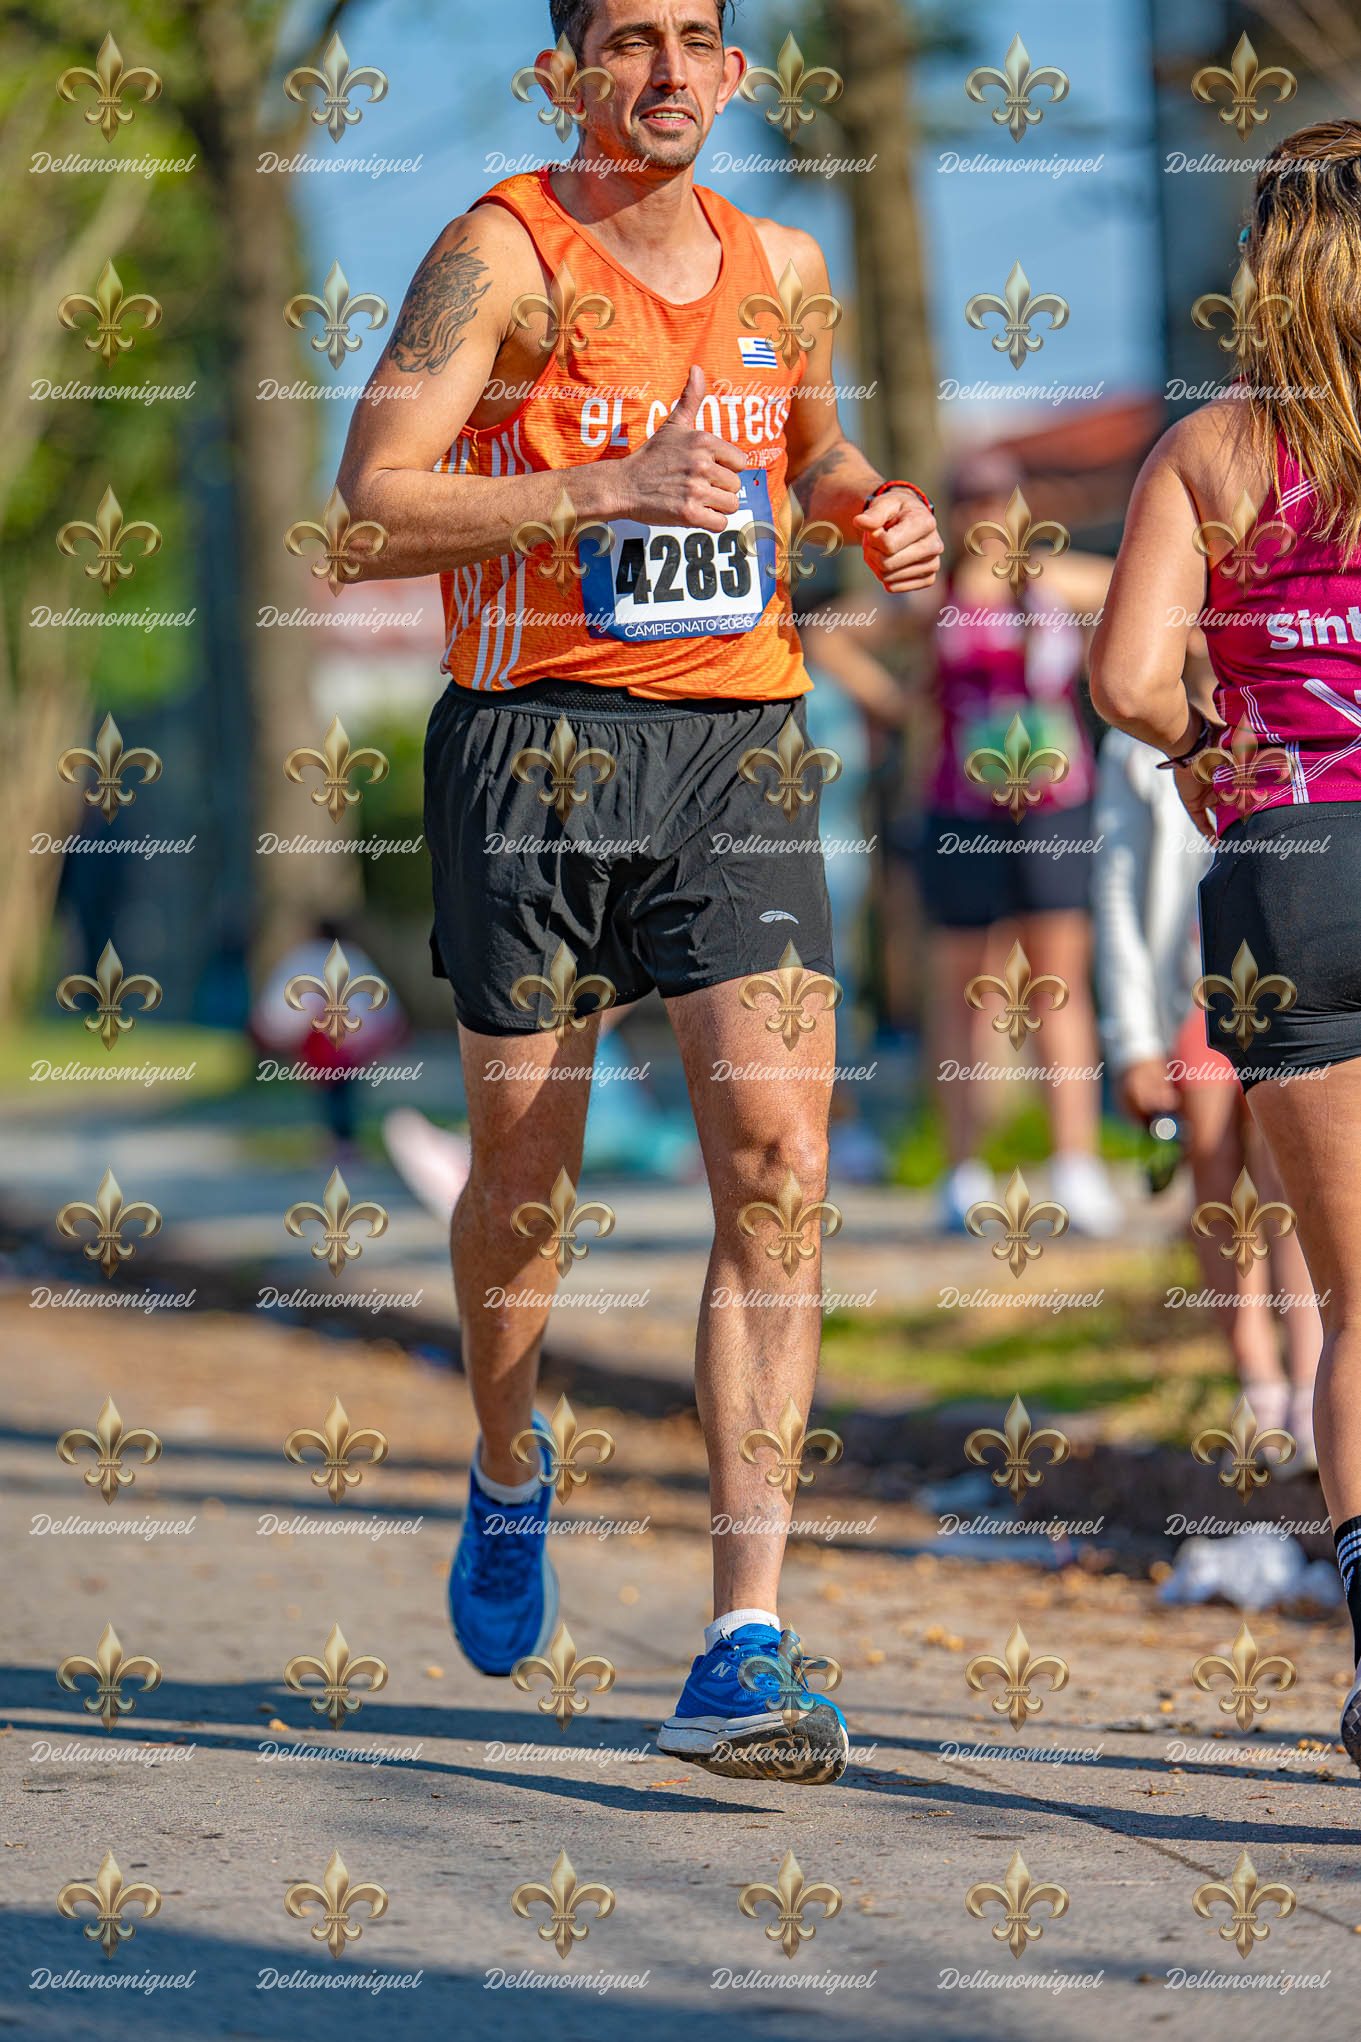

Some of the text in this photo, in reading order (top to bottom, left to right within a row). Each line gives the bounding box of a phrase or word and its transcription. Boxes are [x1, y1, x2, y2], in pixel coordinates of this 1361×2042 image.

[615, 529, 752, 605] 4283
[624, 616, 754, 638] CAMPEONATO 2026
